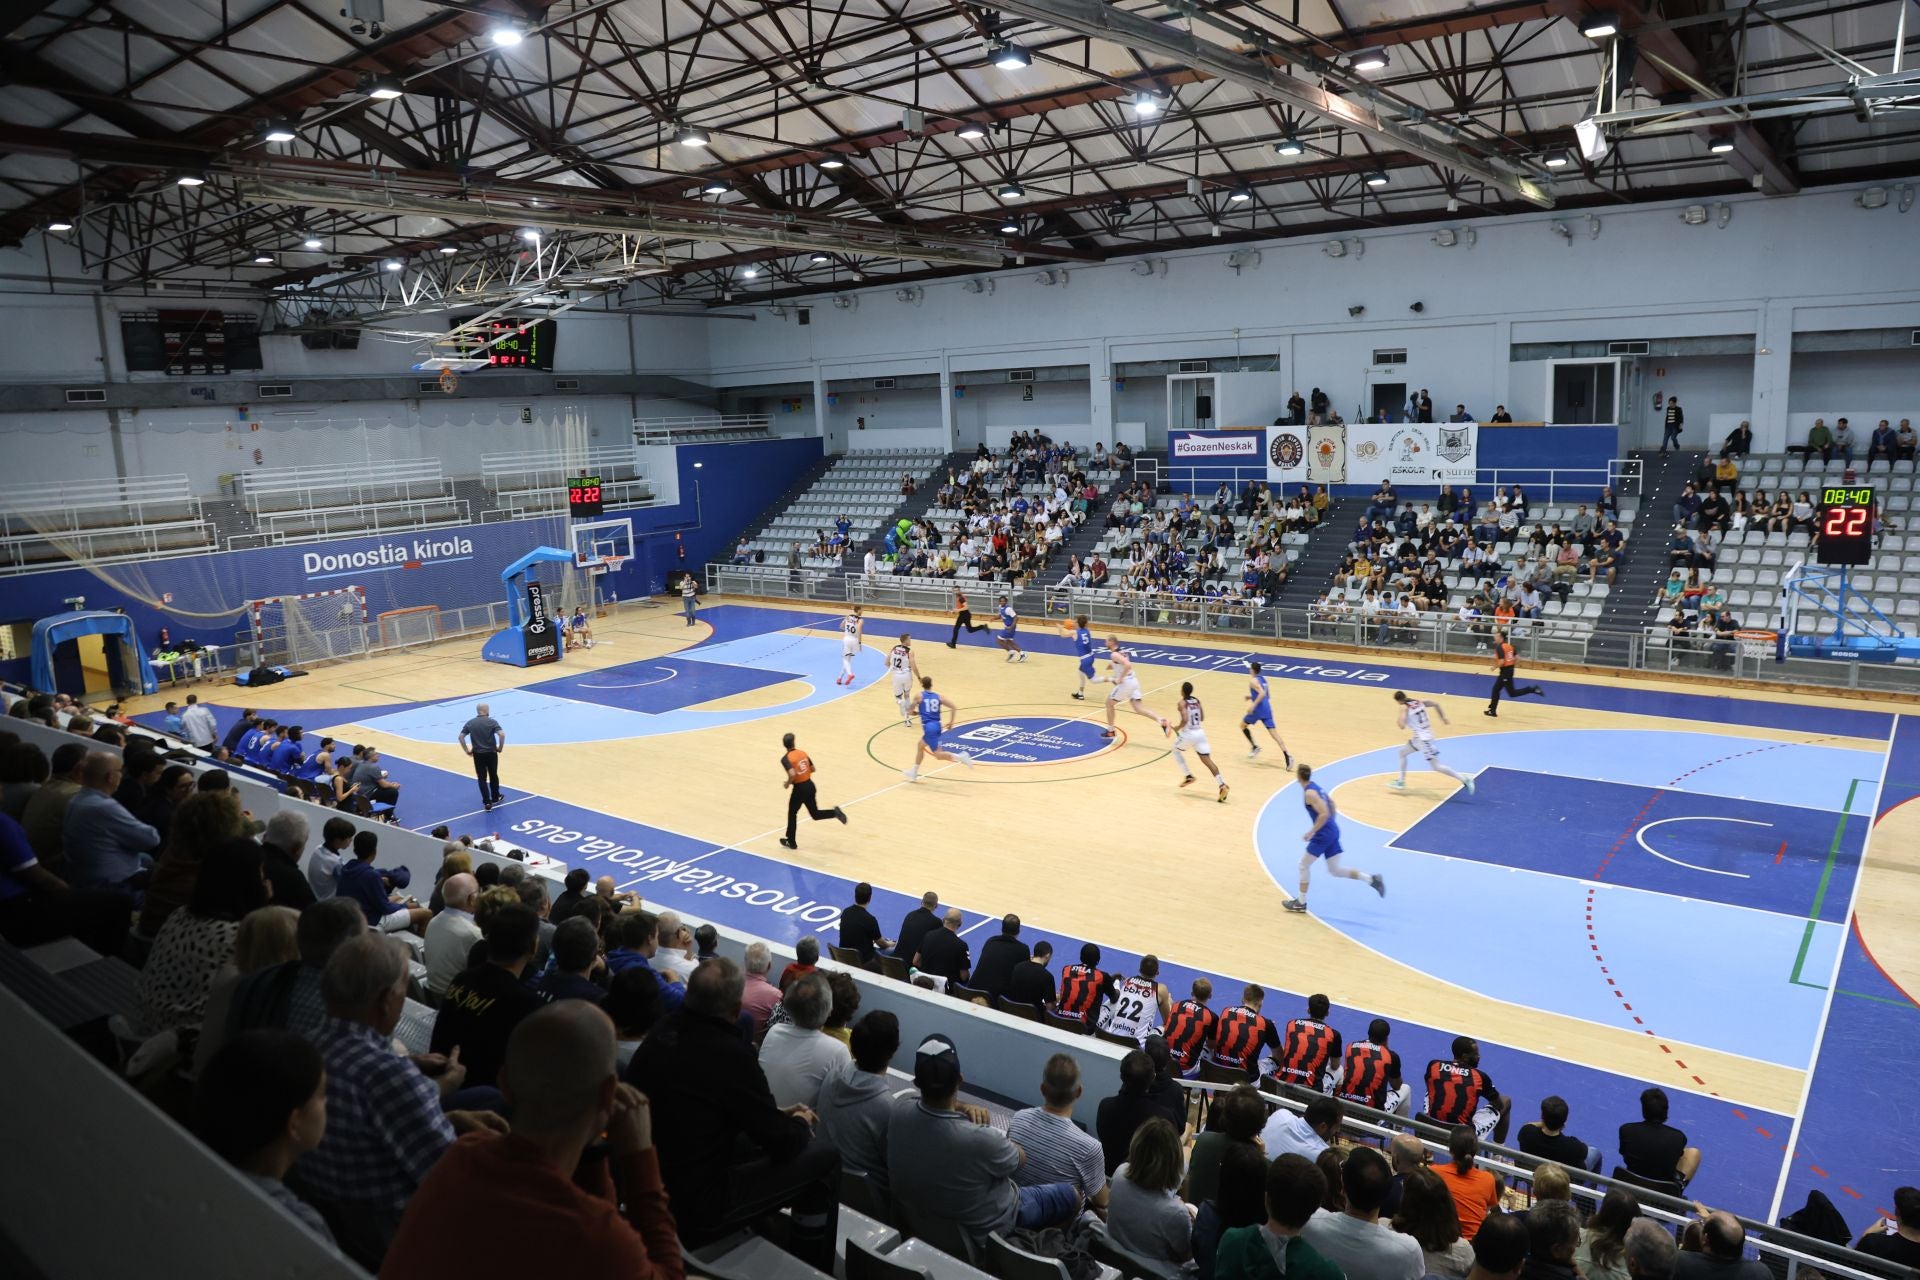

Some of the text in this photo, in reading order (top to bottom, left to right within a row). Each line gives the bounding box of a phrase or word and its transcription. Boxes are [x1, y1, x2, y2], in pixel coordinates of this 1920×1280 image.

[496, 340, 519, 350] 08:40
[1177, 441, 1253, 452] #GoazenNeskak
[583, 488, 600, 502] 22
[1824, 489, 1871, 505] 08:40
[1825, 508, 1867, 536] 22
[304, 536, 473, 574] Donostia kirola
[529, 586, 546, 634] pressing
[846, 624, 857, 634] 30
[1081, 633, 1089, 645] 5
[893, 657, 902, 669] 12
[924, 698, 940, 713] 18
[1072, 965, 1091, 974] SYLLA
[1124, 986, 1140, 996] bbk
[1116, 997, 1144, 1023] 22
[1182, 1001, 1201, 1012] FREY
[1439, 1062, 1470, 1076] JONES
